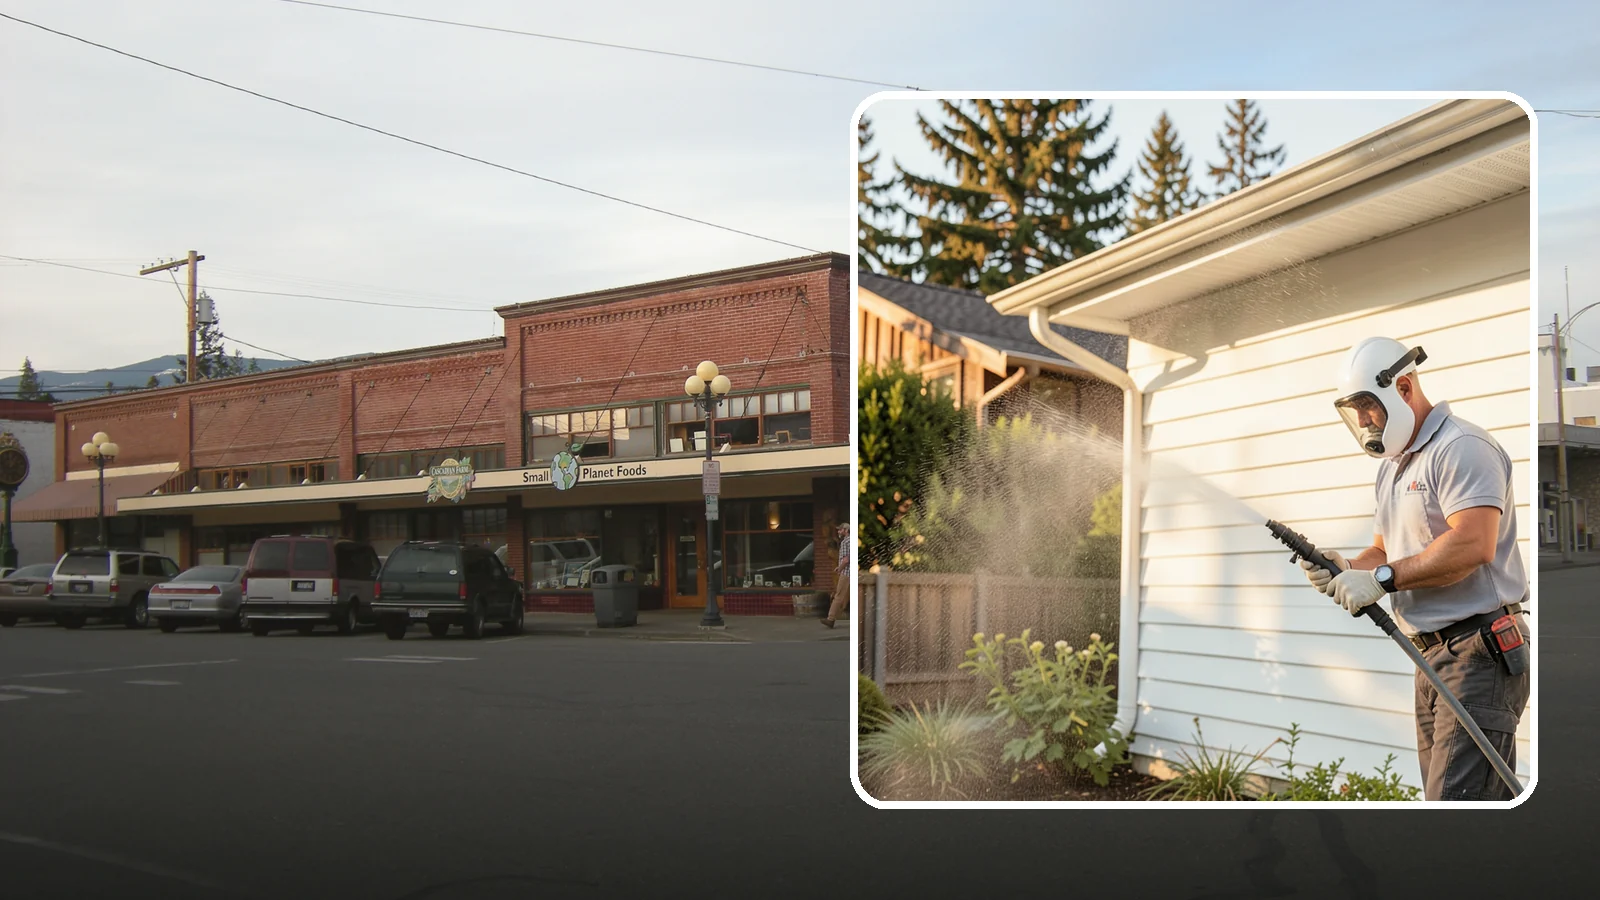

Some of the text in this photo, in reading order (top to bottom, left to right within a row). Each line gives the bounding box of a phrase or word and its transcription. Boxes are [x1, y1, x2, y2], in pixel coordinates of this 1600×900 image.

[523, 464, 647, 482] Small Planet Foods
